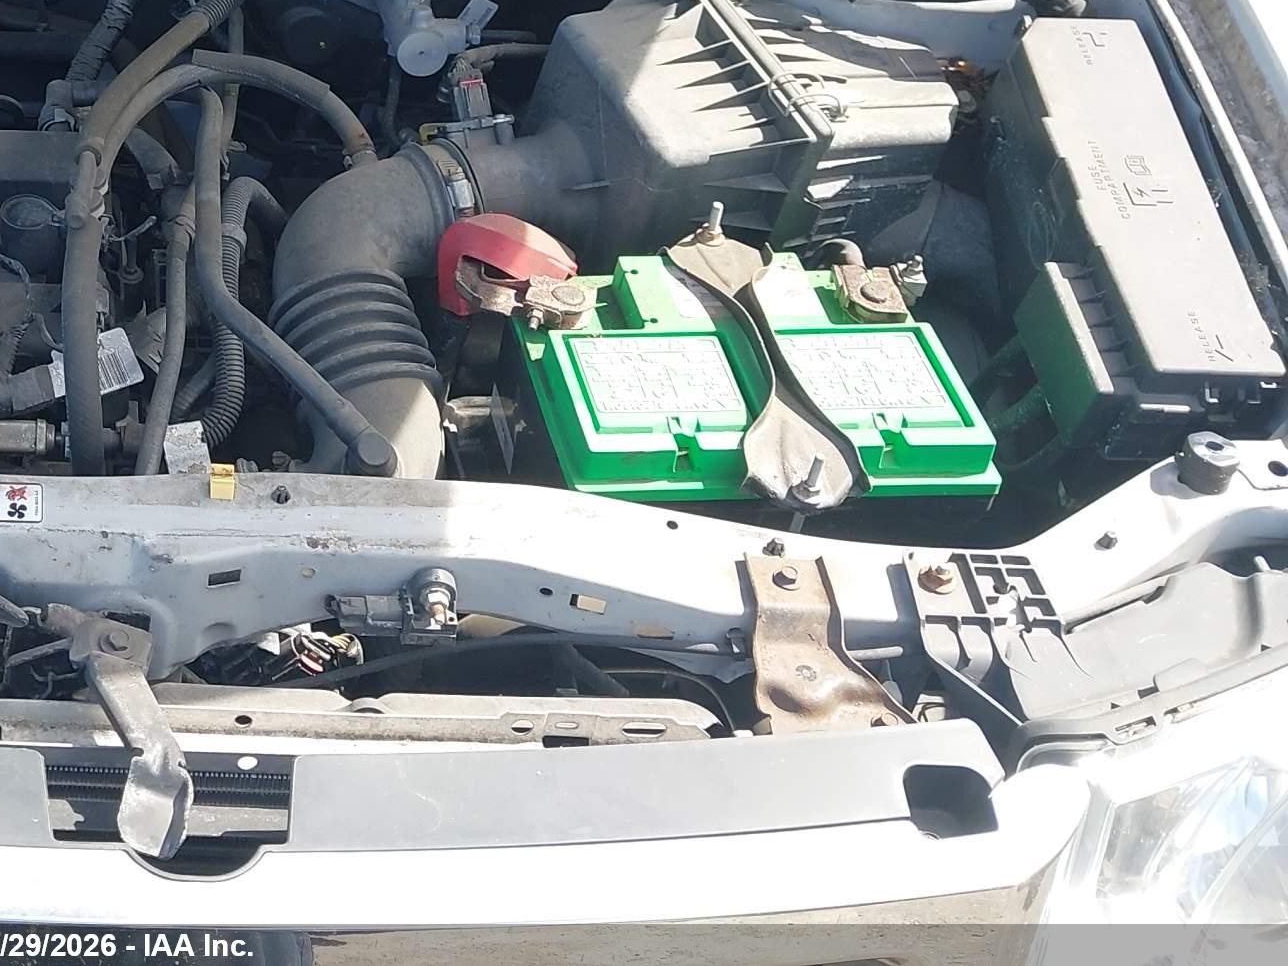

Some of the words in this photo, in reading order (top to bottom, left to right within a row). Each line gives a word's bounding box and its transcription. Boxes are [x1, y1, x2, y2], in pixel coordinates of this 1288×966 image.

[1070, 25, 1093, 65] RELEASE
[1088, 166, 1107, 191] FUSE
[1088, 140, 1131, 220] COMPARTMENT
[1187, 312, 1216, 362] RELEASE
